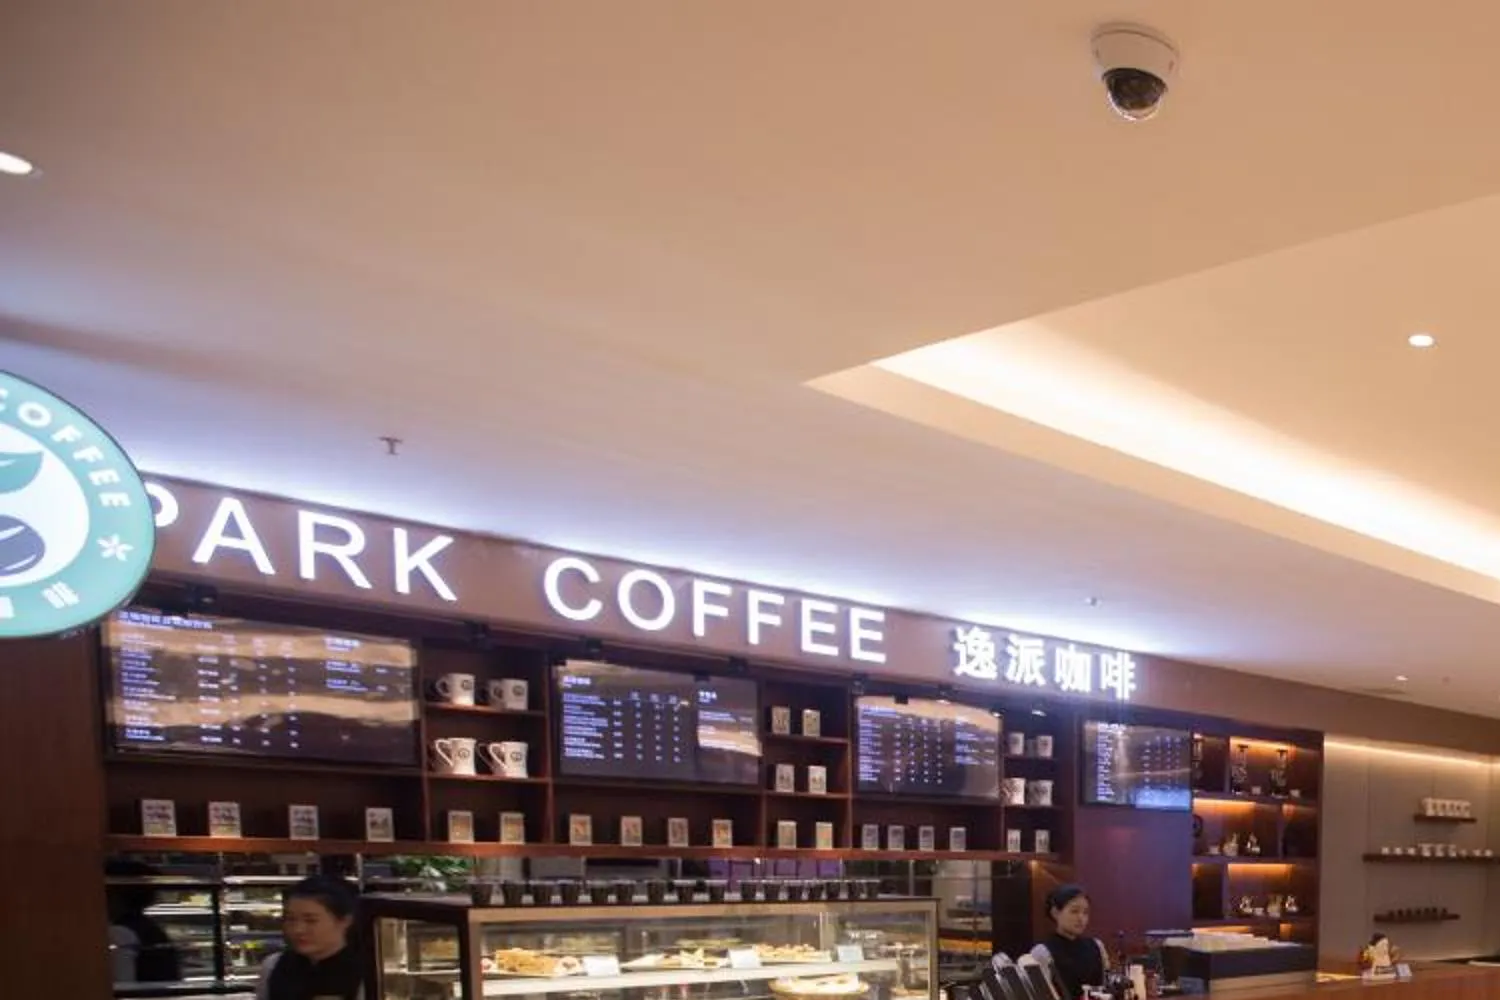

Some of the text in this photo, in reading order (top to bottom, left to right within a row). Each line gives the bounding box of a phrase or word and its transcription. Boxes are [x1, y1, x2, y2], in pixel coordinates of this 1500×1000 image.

[543, 557, 886, 664] COFFEE
[953, 626, 1137, 701] 逸派咖啡
